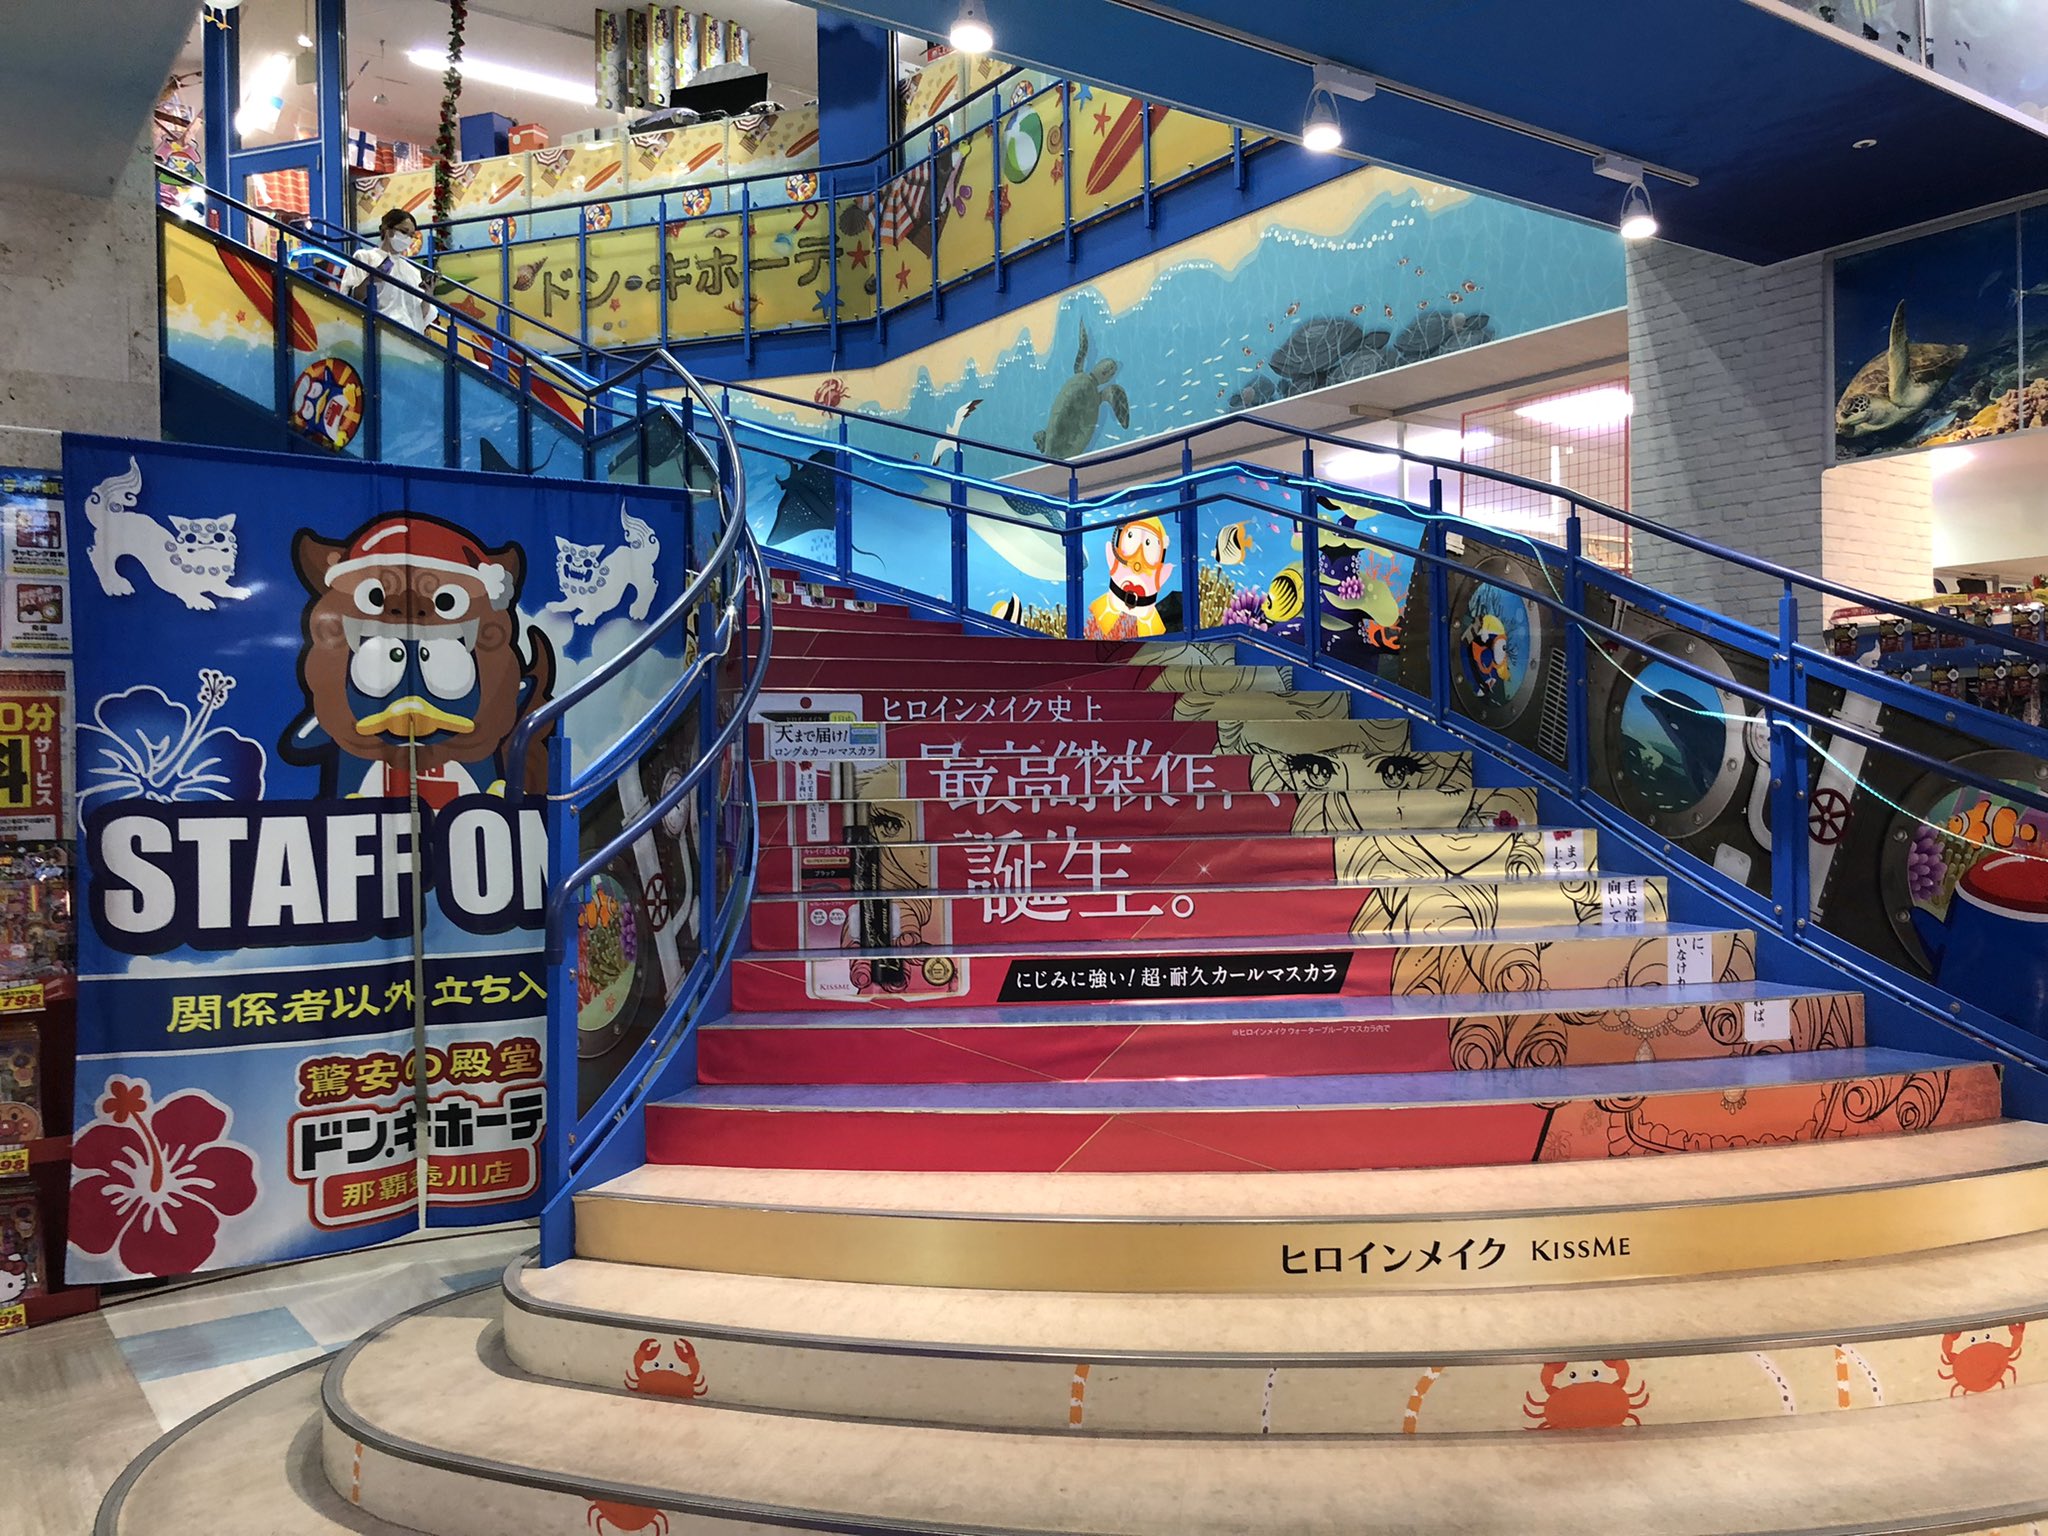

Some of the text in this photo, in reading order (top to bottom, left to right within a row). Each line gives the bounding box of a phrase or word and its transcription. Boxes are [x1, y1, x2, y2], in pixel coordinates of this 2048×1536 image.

[883, 695, 1103, 722] ヒロインメイク史上
[34, 736, 54, 806] サービス
[101, 812, 422, 933] STAFF
[953, 826, 1195, 924] 誕生。
[166, 970, 548, 1033] 関係者以外立ち入
[307, 1043, 538, 1100] 驚安の殿堂
[1282, 1238, 1506, 1274] ヒロインメイク
